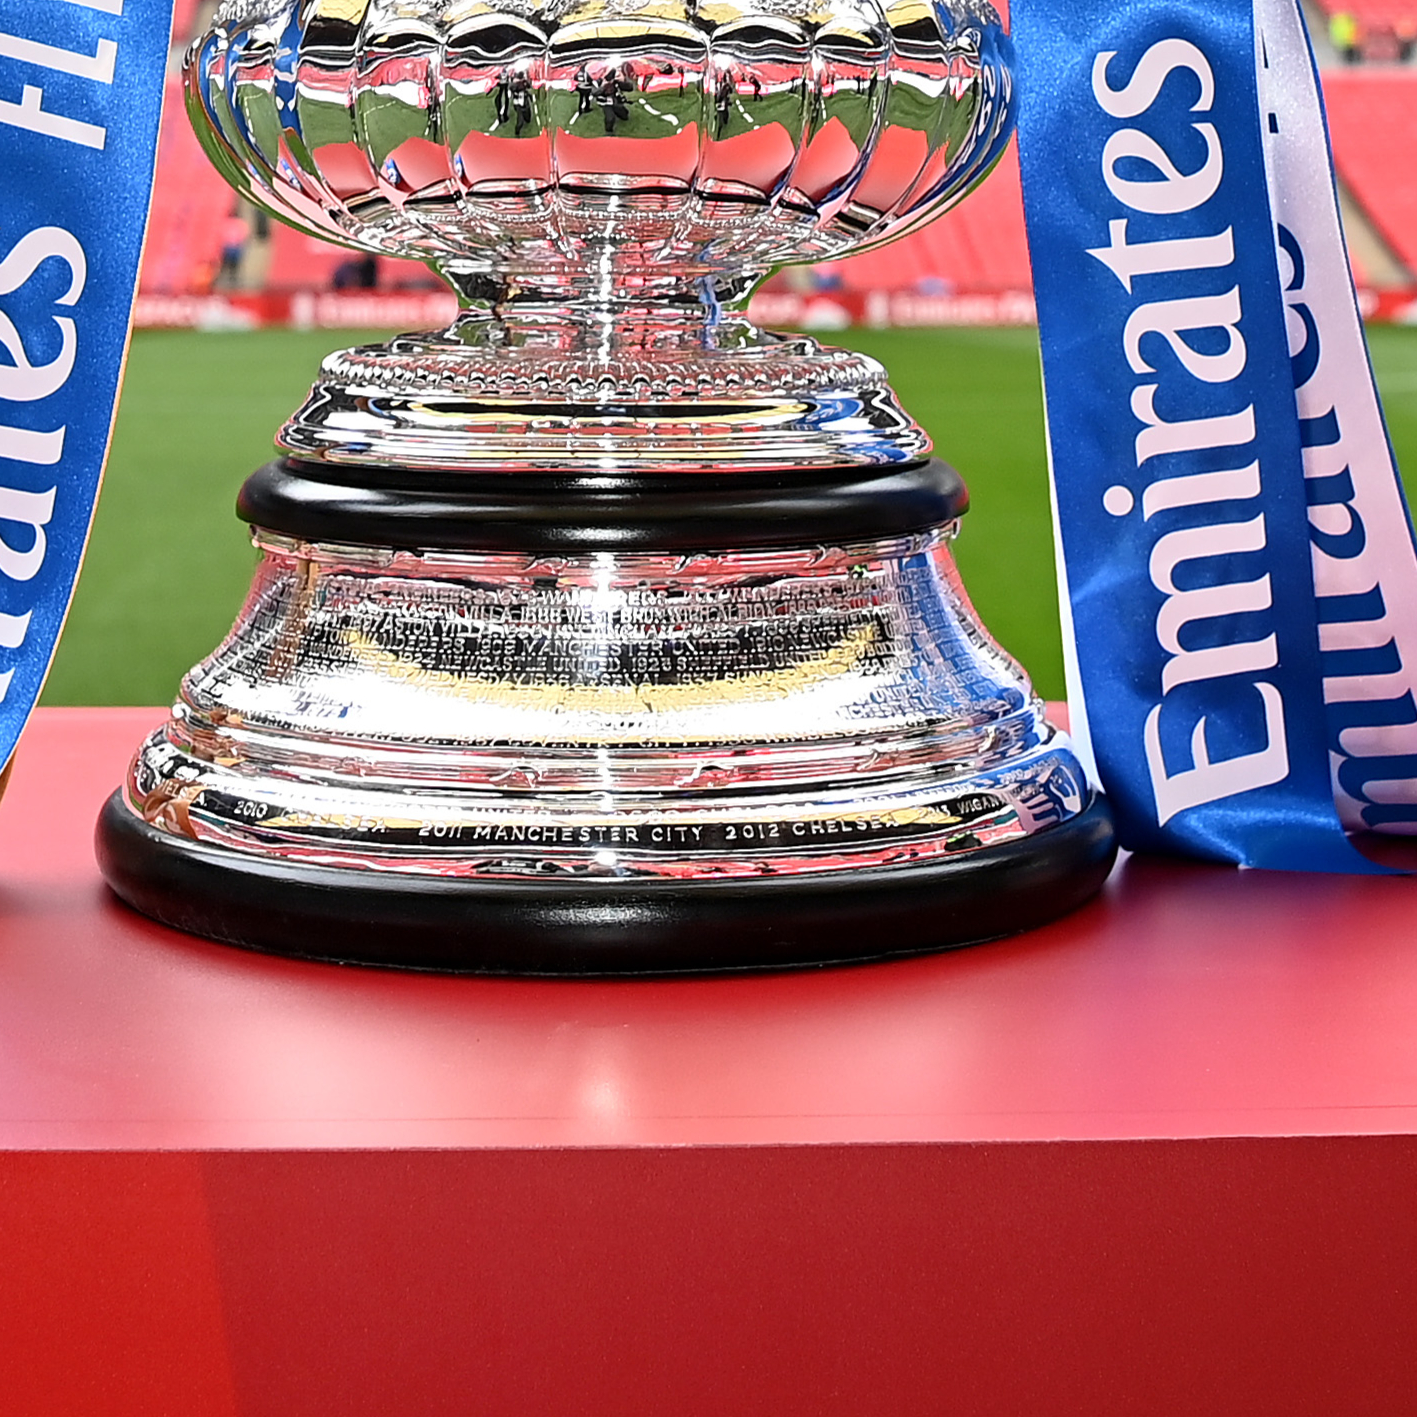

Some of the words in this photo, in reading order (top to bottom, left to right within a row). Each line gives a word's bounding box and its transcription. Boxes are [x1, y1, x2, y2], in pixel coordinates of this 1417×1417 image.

[1086, 37, 1290, 828] Emirates
[233, 799, 269, 820] 2010
[418, 820, 463, 840] 2011
[472, 823, 640, 844] MANCHESTER
[650, 825, 704, 844] CITY
[724, 823, 780, 841] 2012
[791, 814, 900, 837] CHELSEA
